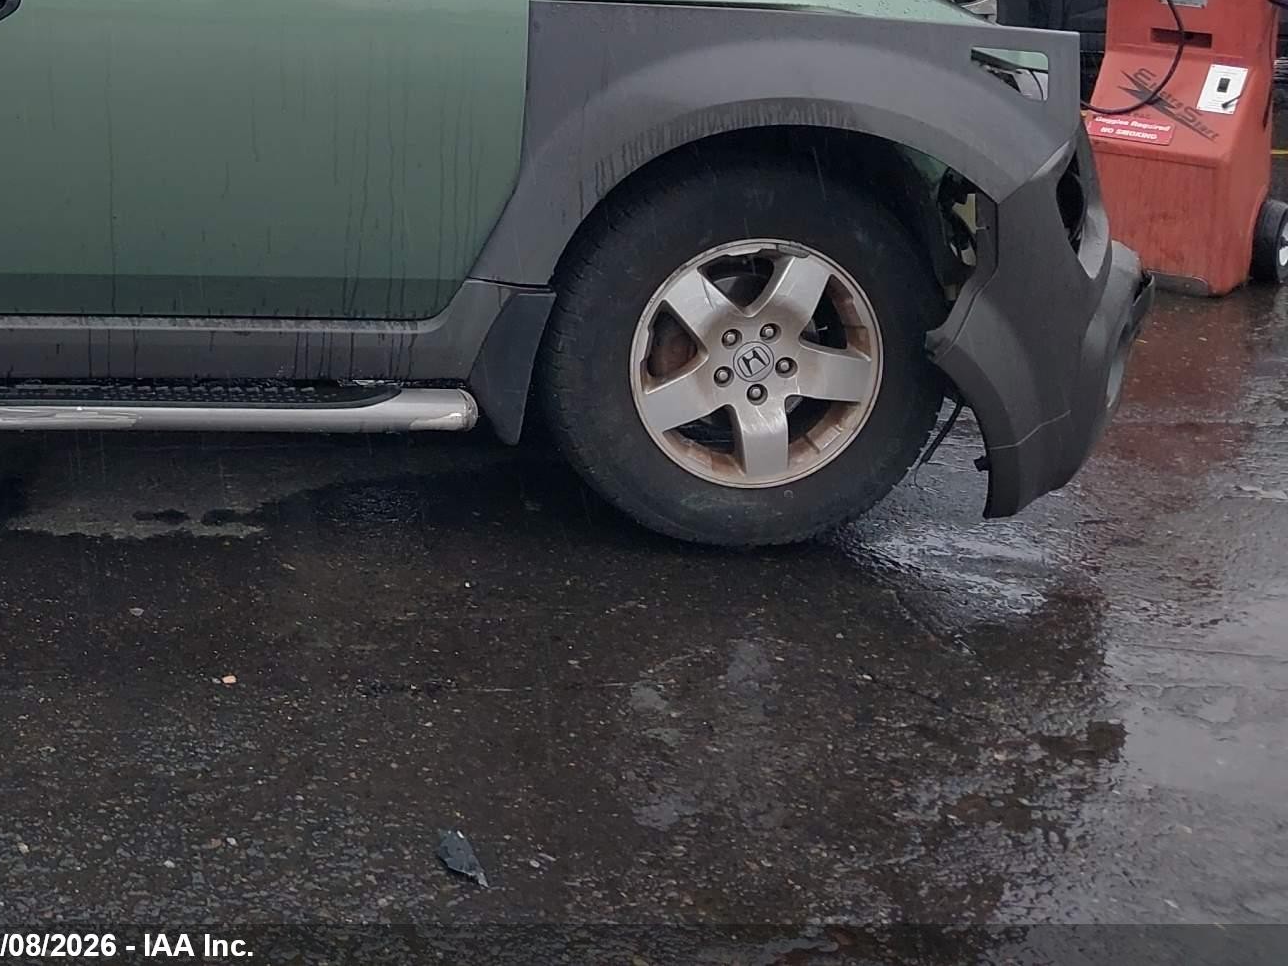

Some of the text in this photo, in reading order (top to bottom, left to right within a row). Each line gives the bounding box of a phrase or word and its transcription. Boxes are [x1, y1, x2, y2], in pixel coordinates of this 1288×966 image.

[1130, 120, 1171, 132] Required
[1100, 126, 1158, 140] NO SMOKING
